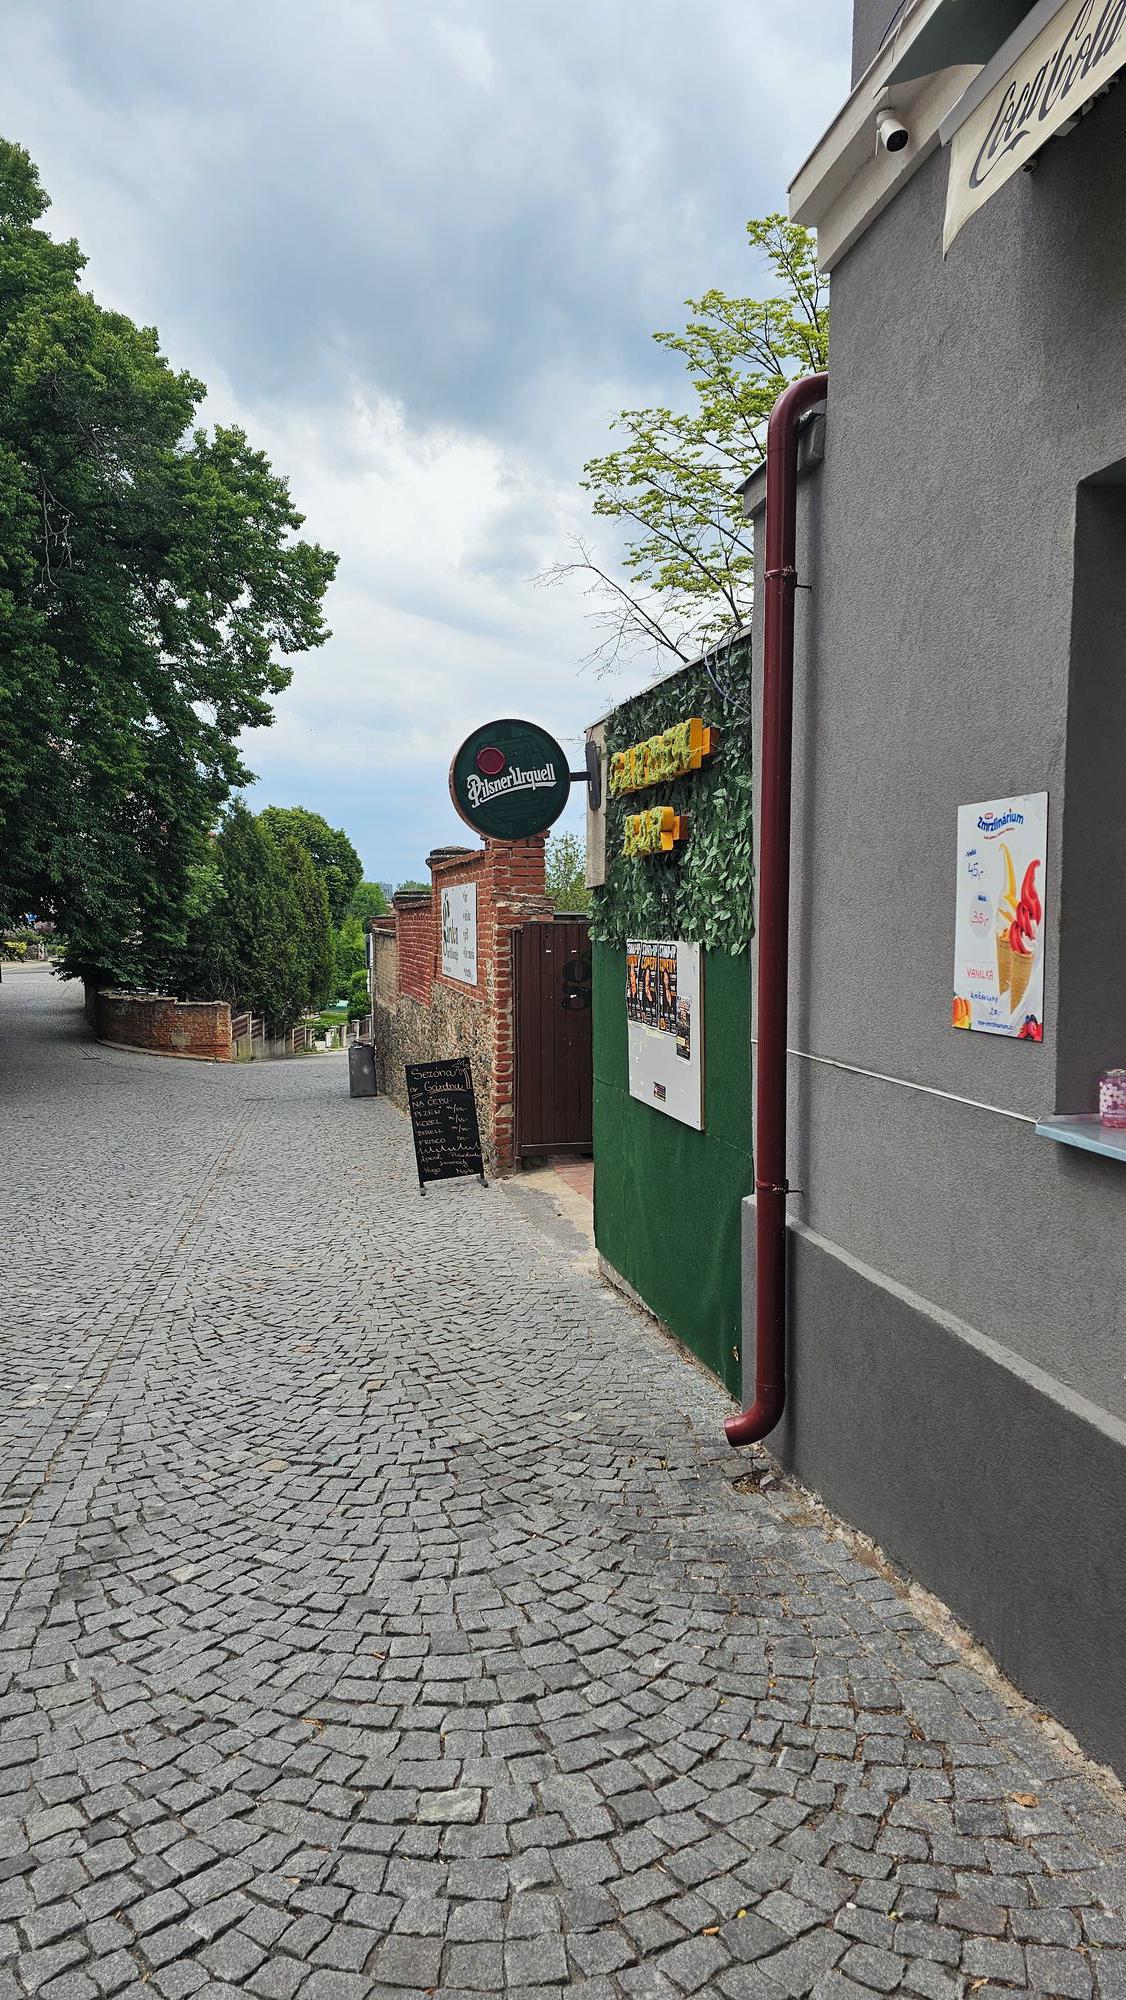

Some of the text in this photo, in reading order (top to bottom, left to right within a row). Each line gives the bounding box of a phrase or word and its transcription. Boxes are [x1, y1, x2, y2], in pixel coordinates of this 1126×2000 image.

[466, 763, 556, 808] Pilsner Urquell
[977, 809, 1025, 832] Zmrzlinárium
[411, 1067, 456, 1080] Sezóna
